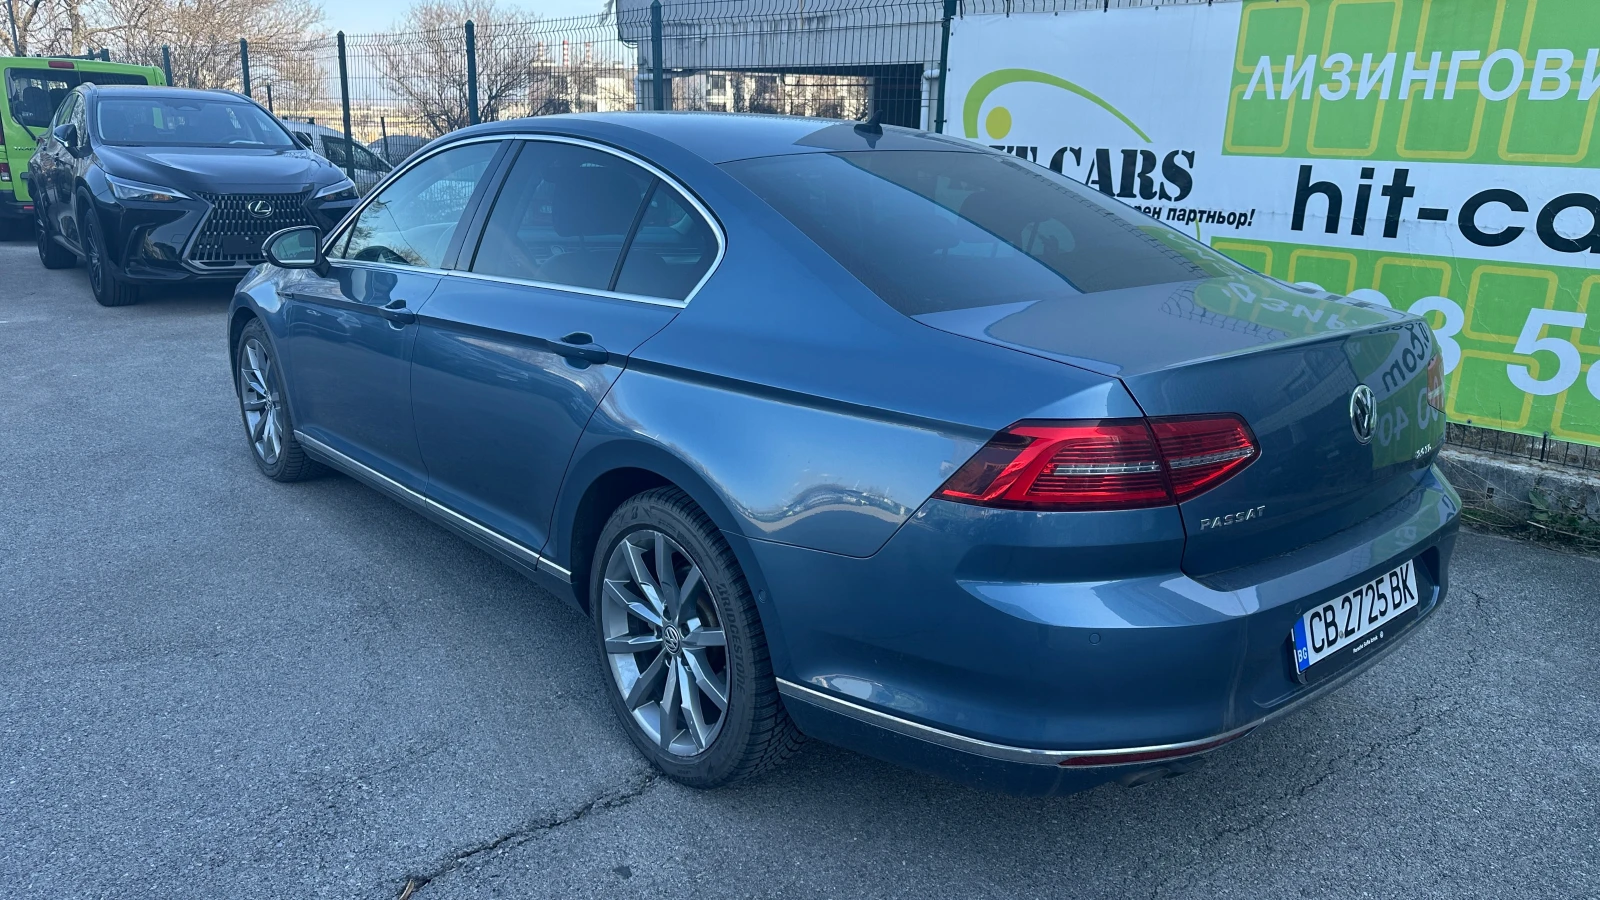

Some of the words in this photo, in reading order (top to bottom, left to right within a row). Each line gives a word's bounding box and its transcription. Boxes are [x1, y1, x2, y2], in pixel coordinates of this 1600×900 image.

[1166, 207, 1256, 229] партньор!
[1291, 165, 1600, 254] hit-ca
[1507, 308, 1600, 402] 5
[1200, 505, 1266, 530] PASSAT
[715, 583, 745, 695] BRIDGESTONE
[1309, 604, 1338, 654] CB
[1341, 577, 1389, 638] 2725
[1389, 563, 1415, 610] BK
[1298, 647, 1308, 662] BG
